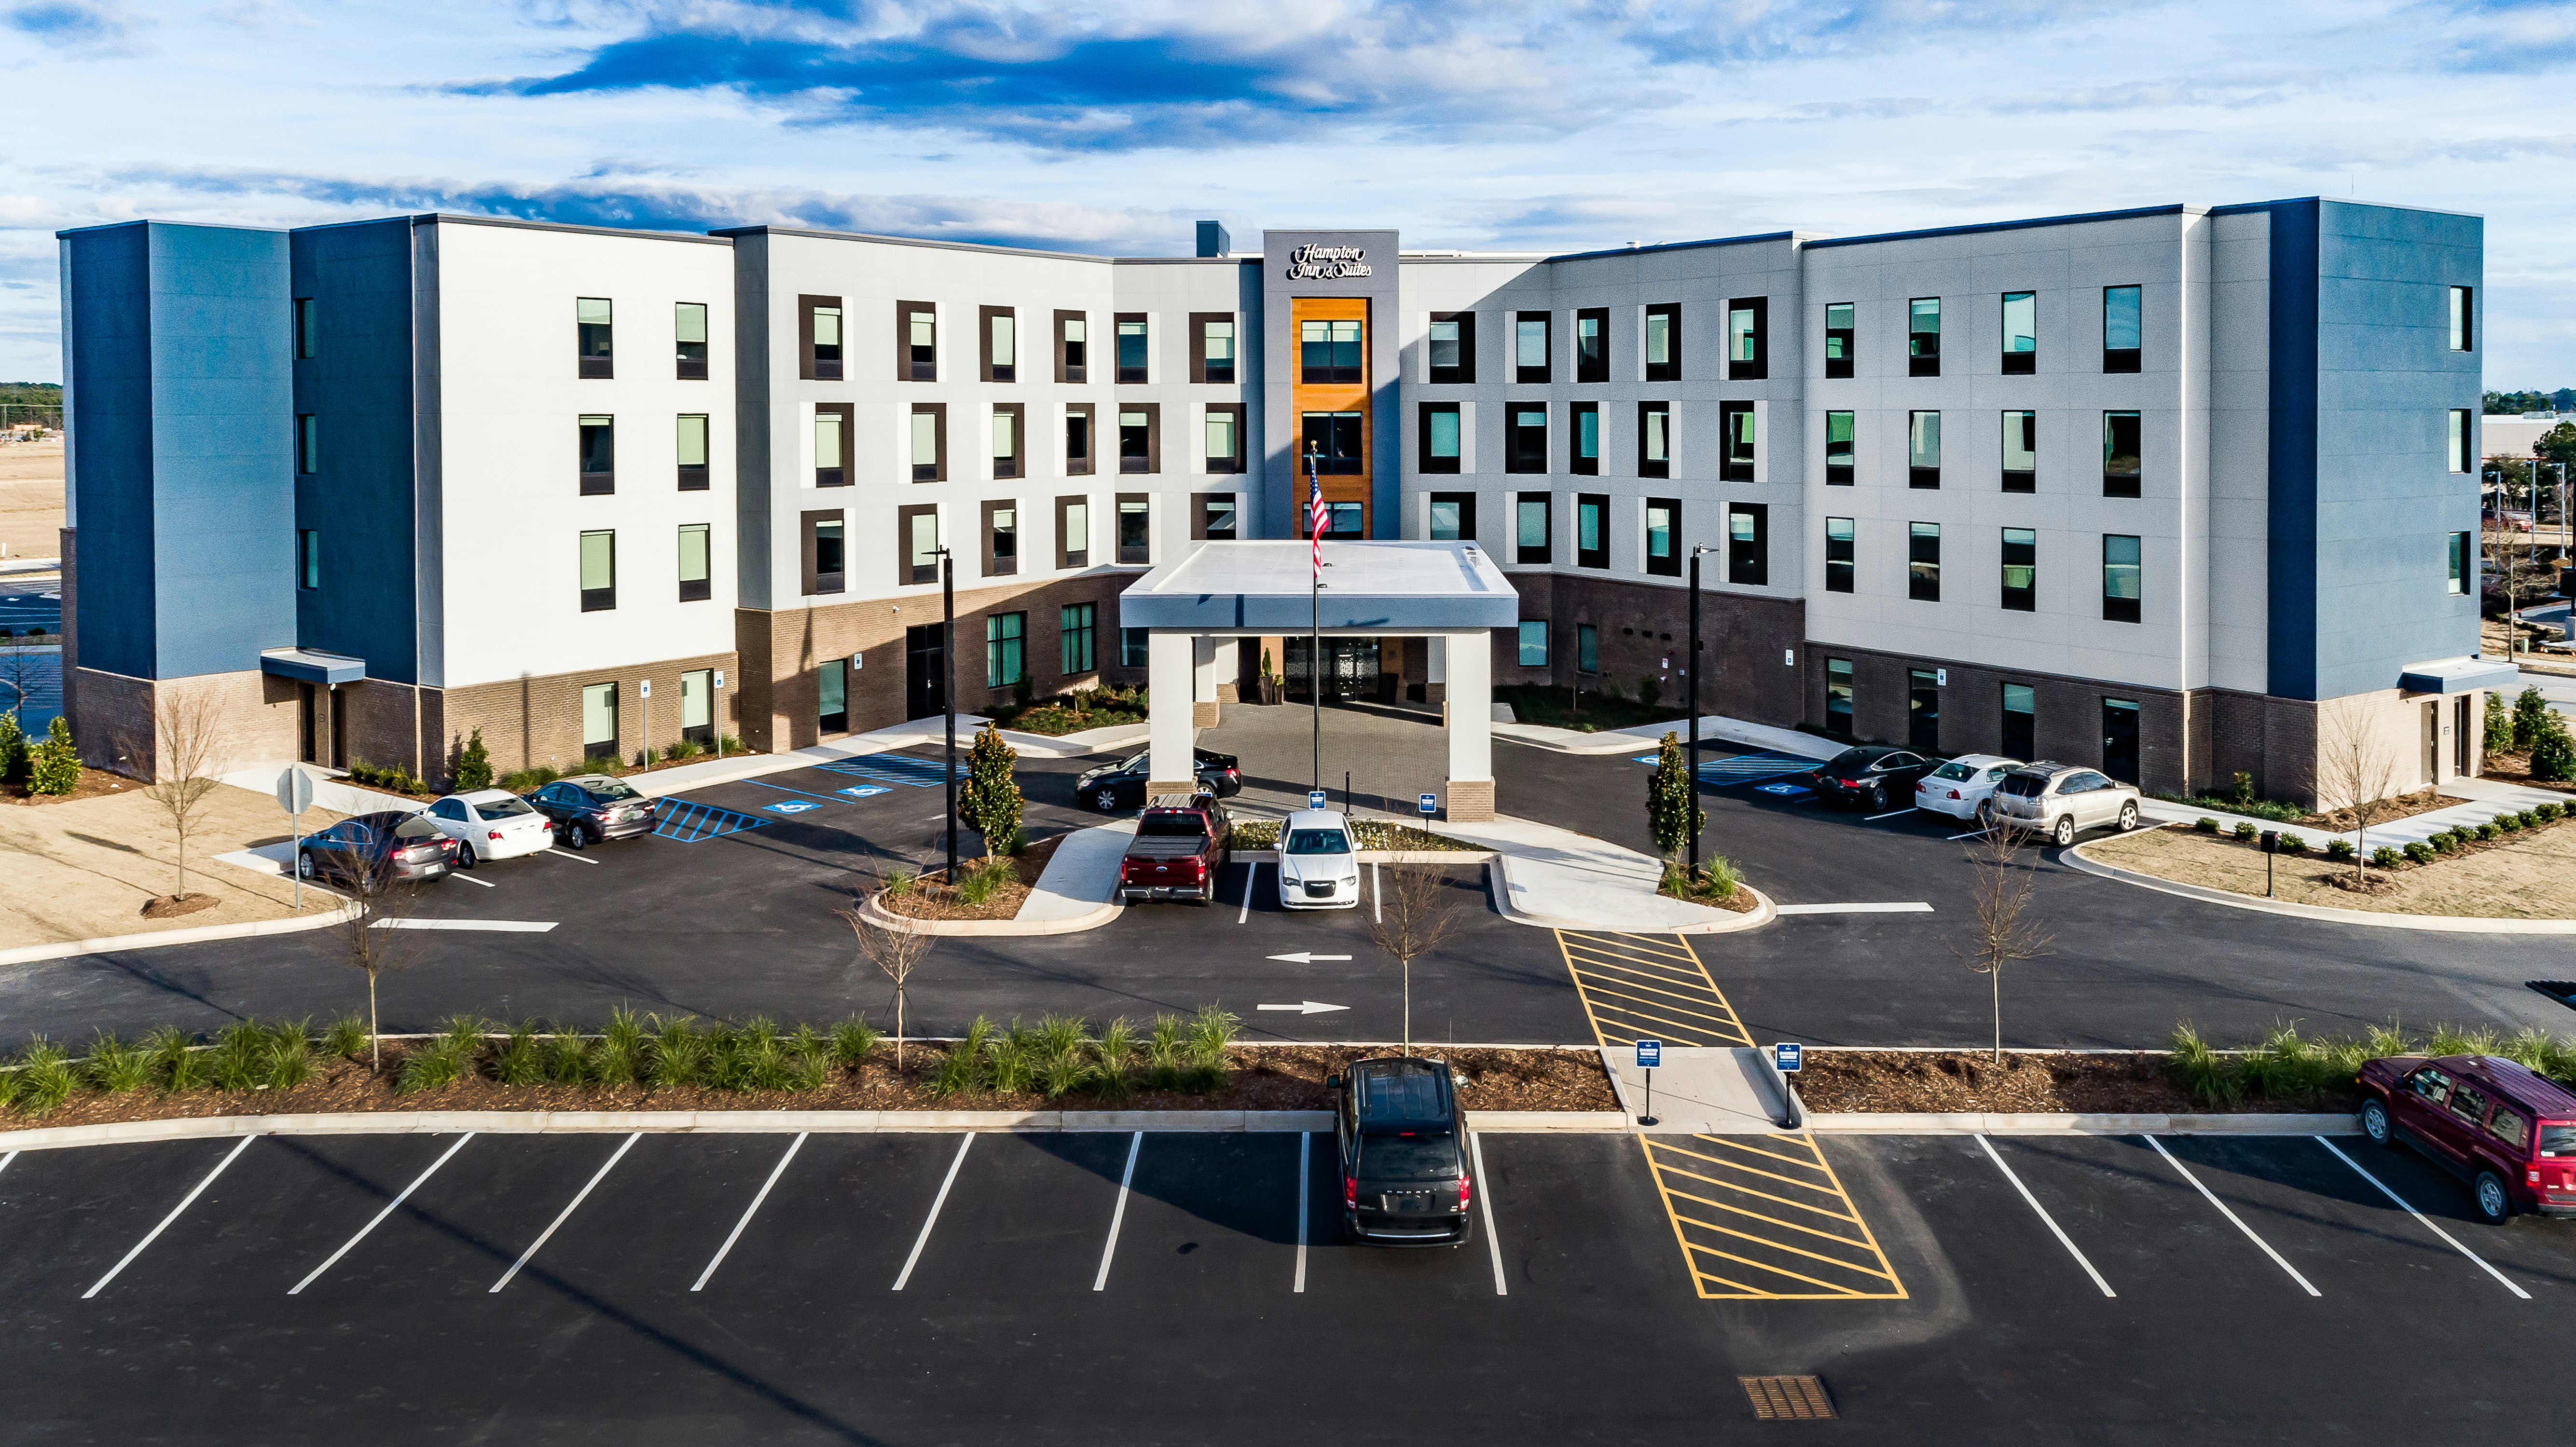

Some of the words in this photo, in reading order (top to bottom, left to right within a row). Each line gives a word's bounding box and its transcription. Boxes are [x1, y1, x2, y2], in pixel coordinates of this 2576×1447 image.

[1295, 243, 1366, 263] Hampton
[1290, 262, 1326, 279] Inn
[1325, 266, 1336, 279] &
[1333, 261, 1372, 277] Suites
